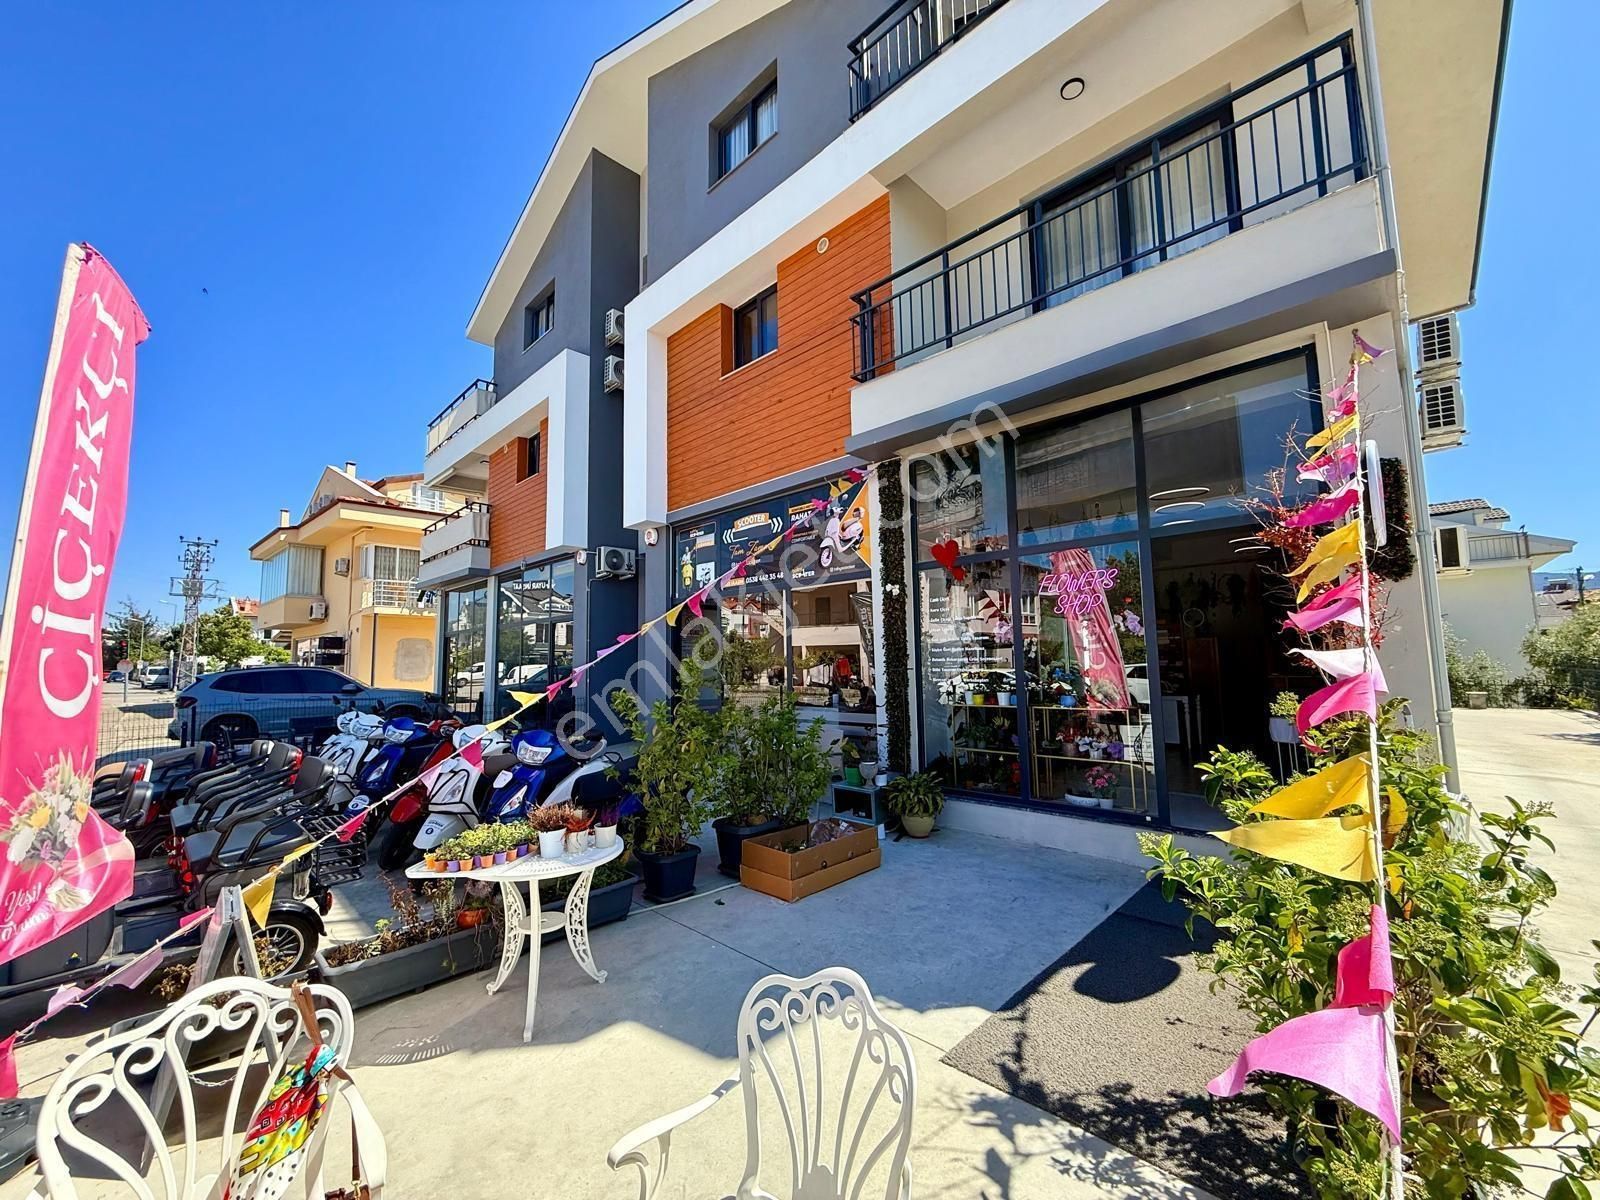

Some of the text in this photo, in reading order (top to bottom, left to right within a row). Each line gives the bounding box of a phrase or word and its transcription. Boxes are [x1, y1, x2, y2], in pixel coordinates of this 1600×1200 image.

[737, 514, 766, 529] SCOOTER
[791, 510, 812, 522] RAHAT
[1038, 568, 1118, 593] FLOWERS
[1053, 593, 1102, 615] SHOP
